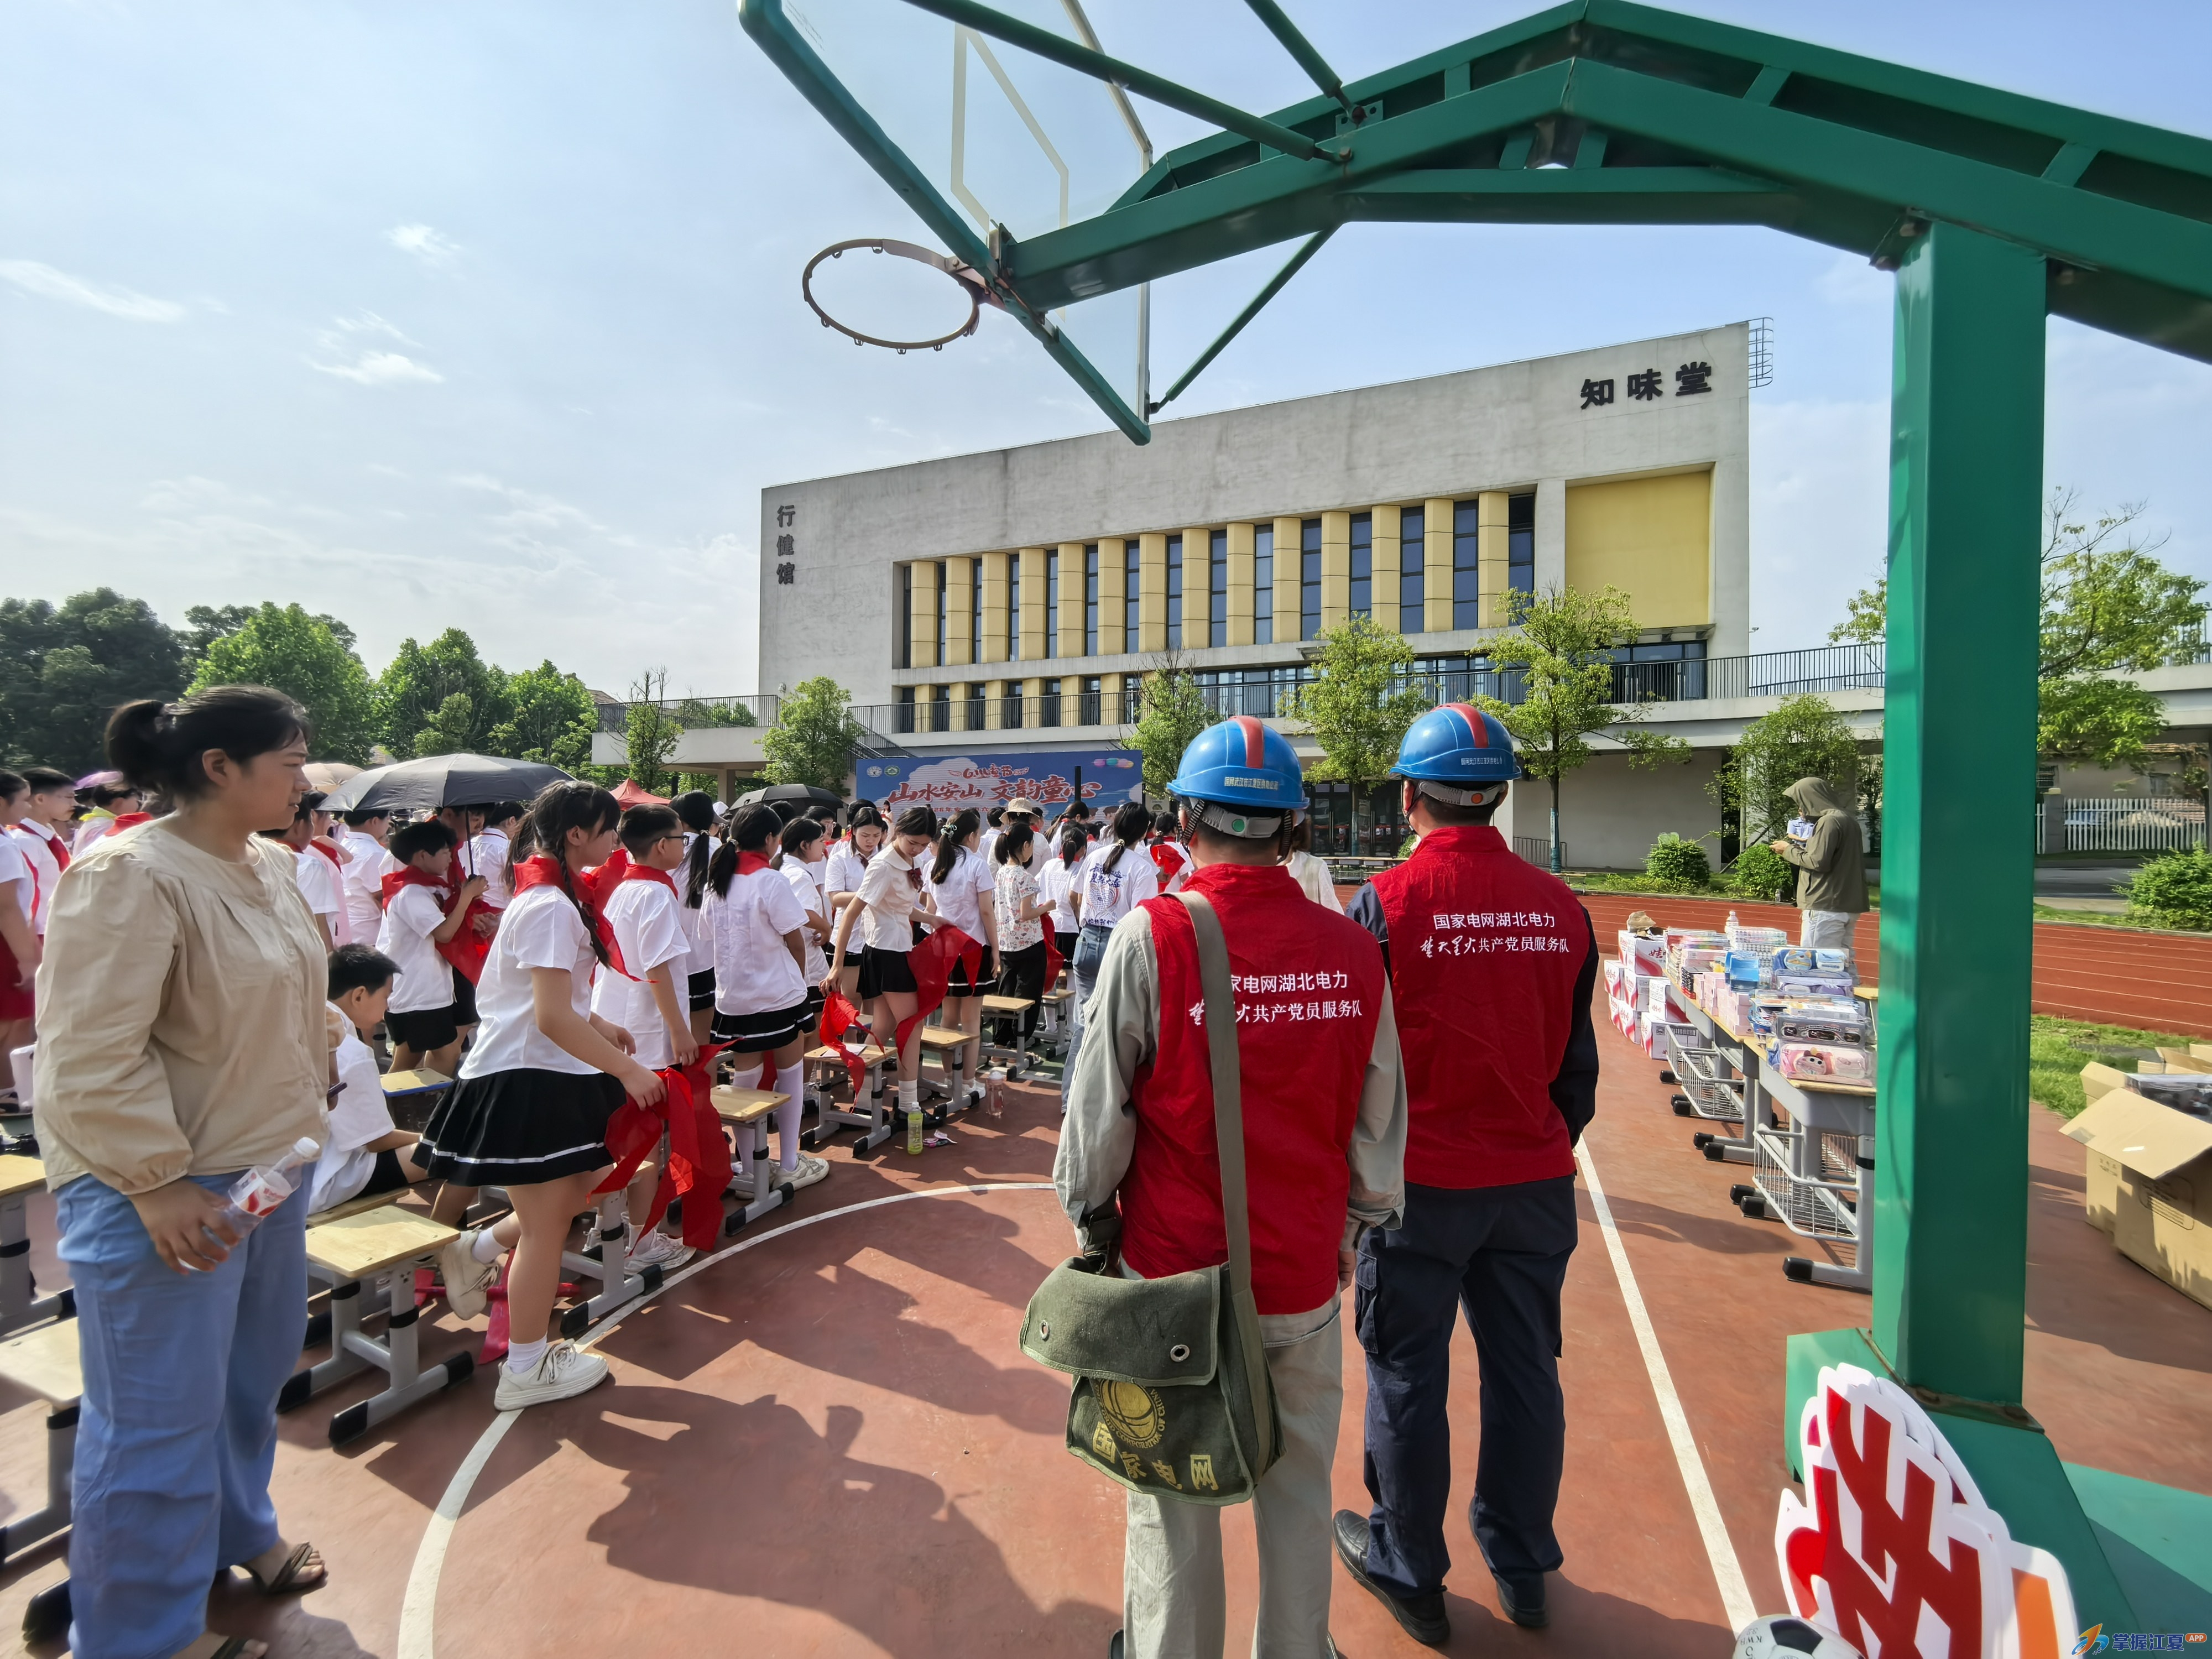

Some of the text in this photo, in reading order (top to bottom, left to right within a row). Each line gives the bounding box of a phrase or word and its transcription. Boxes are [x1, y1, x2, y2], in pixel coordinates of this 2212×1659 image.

[1580, 361, 1712, 410] 知味堂
[776, 504, 796, 585] 行健馆
[888, 781, 983, 804] 山水安山
[1433, 911, 1556, 930] 国家电网湖北电力
[1420, 935, 1570, 959] 楚天星火共产党员服务队
[1230, 970, 1348, 994] 家电网湖北电力
[1188, 998, 1363, 1026] 楚火共产党员服务队
